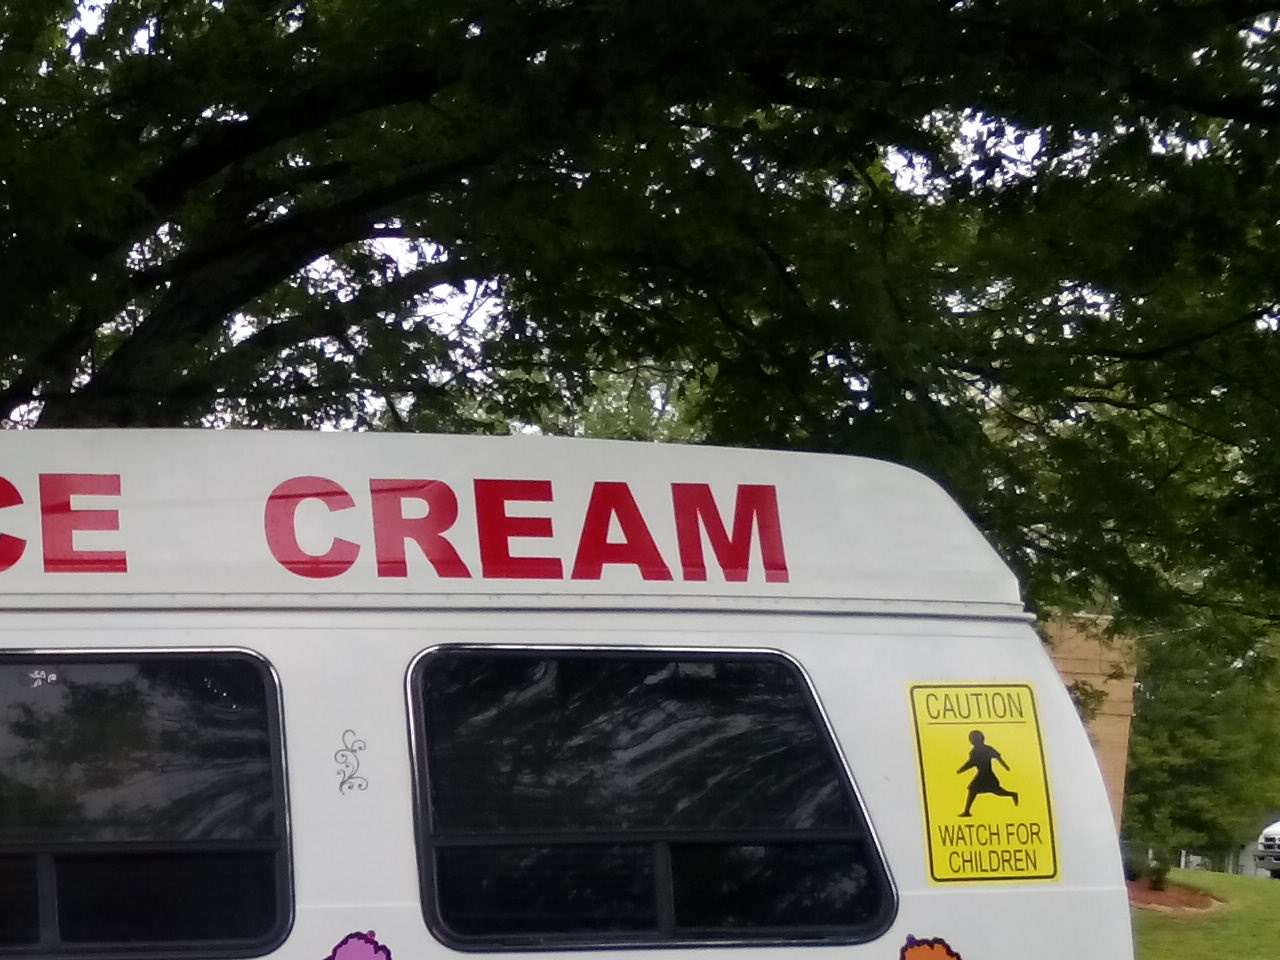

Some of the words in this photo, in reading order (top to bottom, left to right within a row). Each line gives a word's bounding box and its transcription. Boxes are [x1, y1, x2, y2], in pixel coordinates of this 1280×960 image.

[263, 474, 791, 584] CREAM
[925, 692, 1024, 719] CAUTION
[938, 823, 1001, 847] WATCH
[1006, 822, 1043, 845] FOR
[948, 849, 1038, 874] CHILDREN
